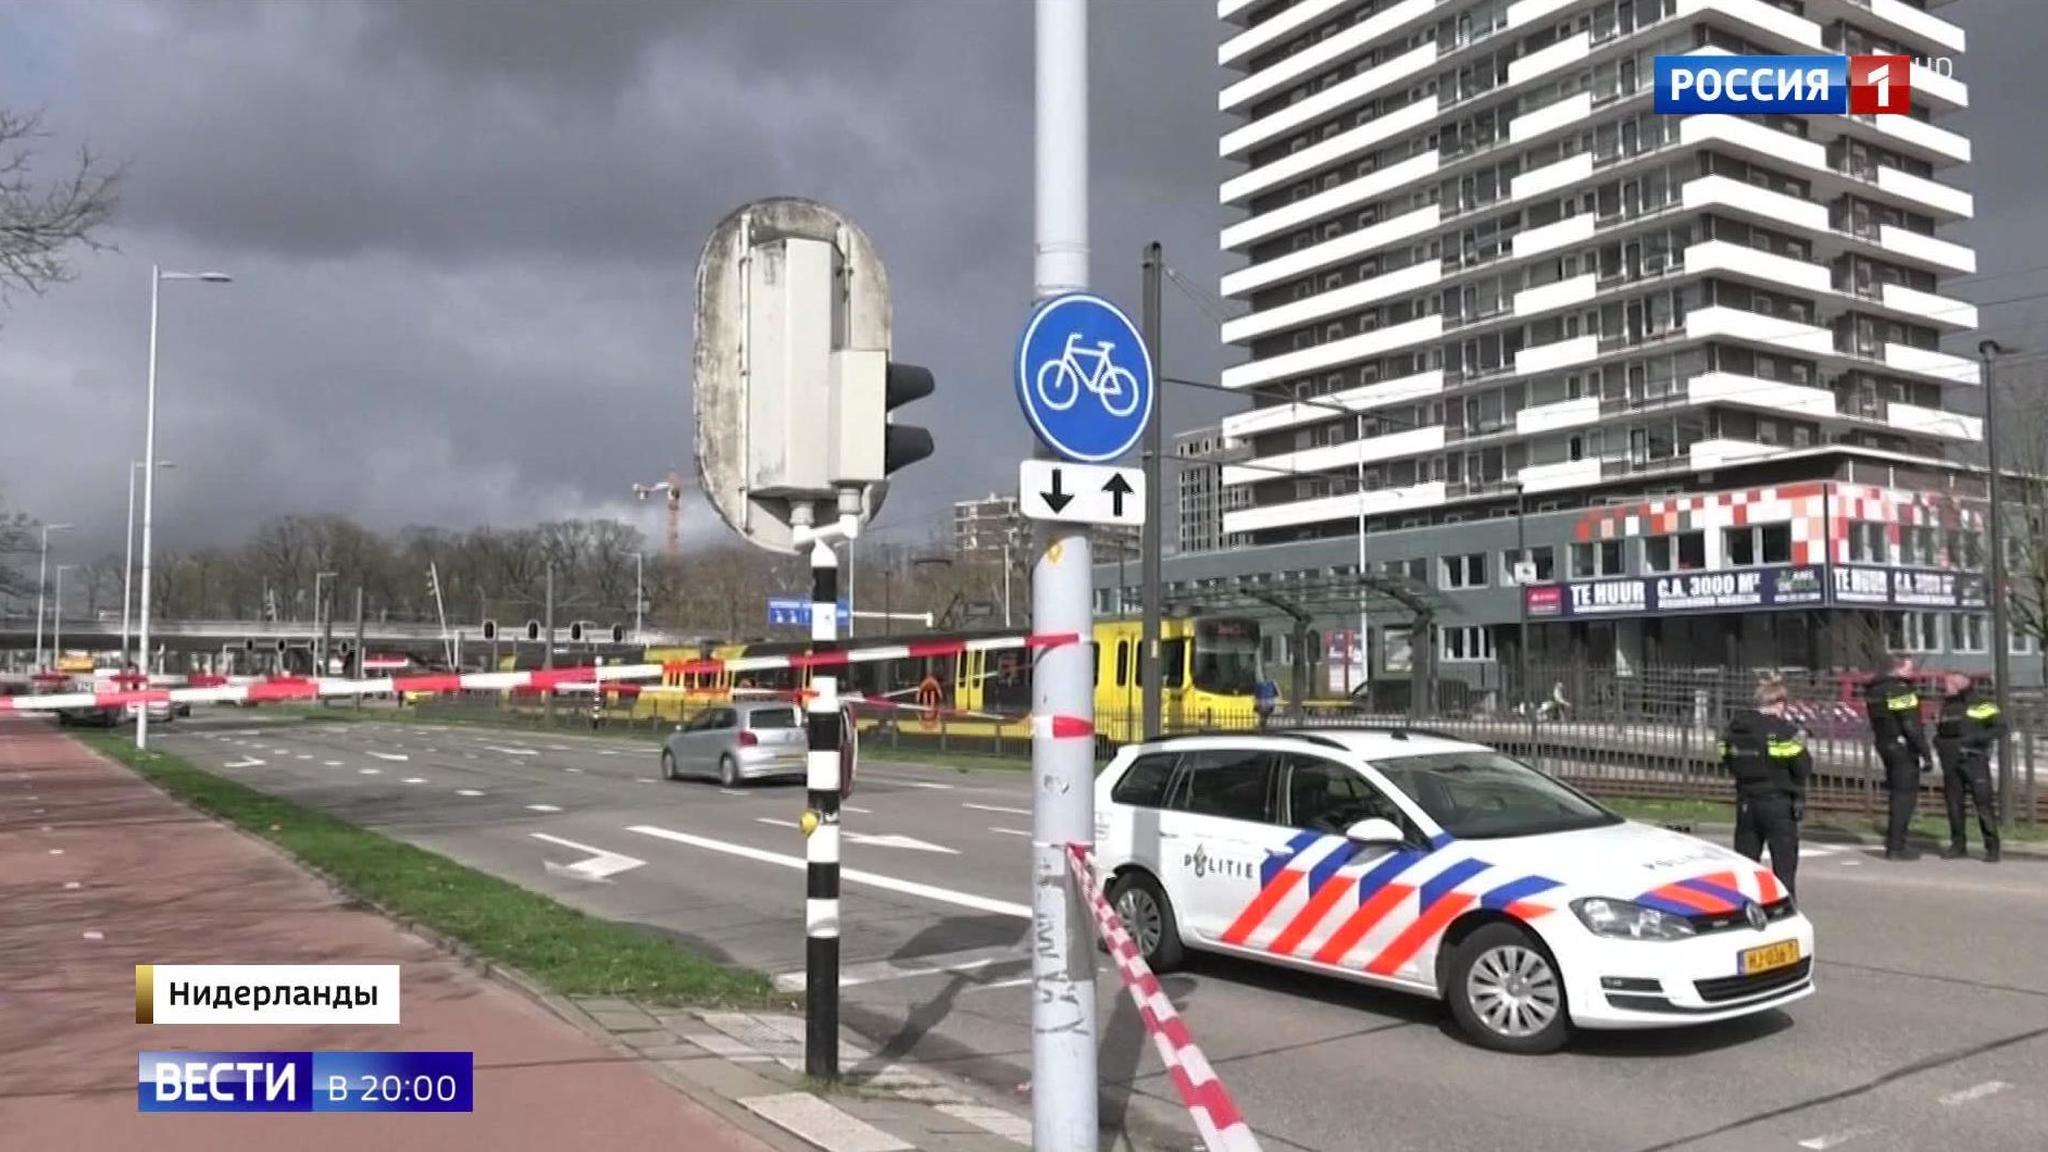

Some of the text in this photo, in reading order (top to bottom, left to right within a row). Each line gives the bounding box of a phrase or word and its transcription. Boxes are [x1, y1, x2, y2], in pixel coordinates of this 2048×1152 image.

[1571, 584, 1593, 606] TE
[1594, 581, 1646, 604] HUUR
[1690, 575, 1735, 597] 3000
